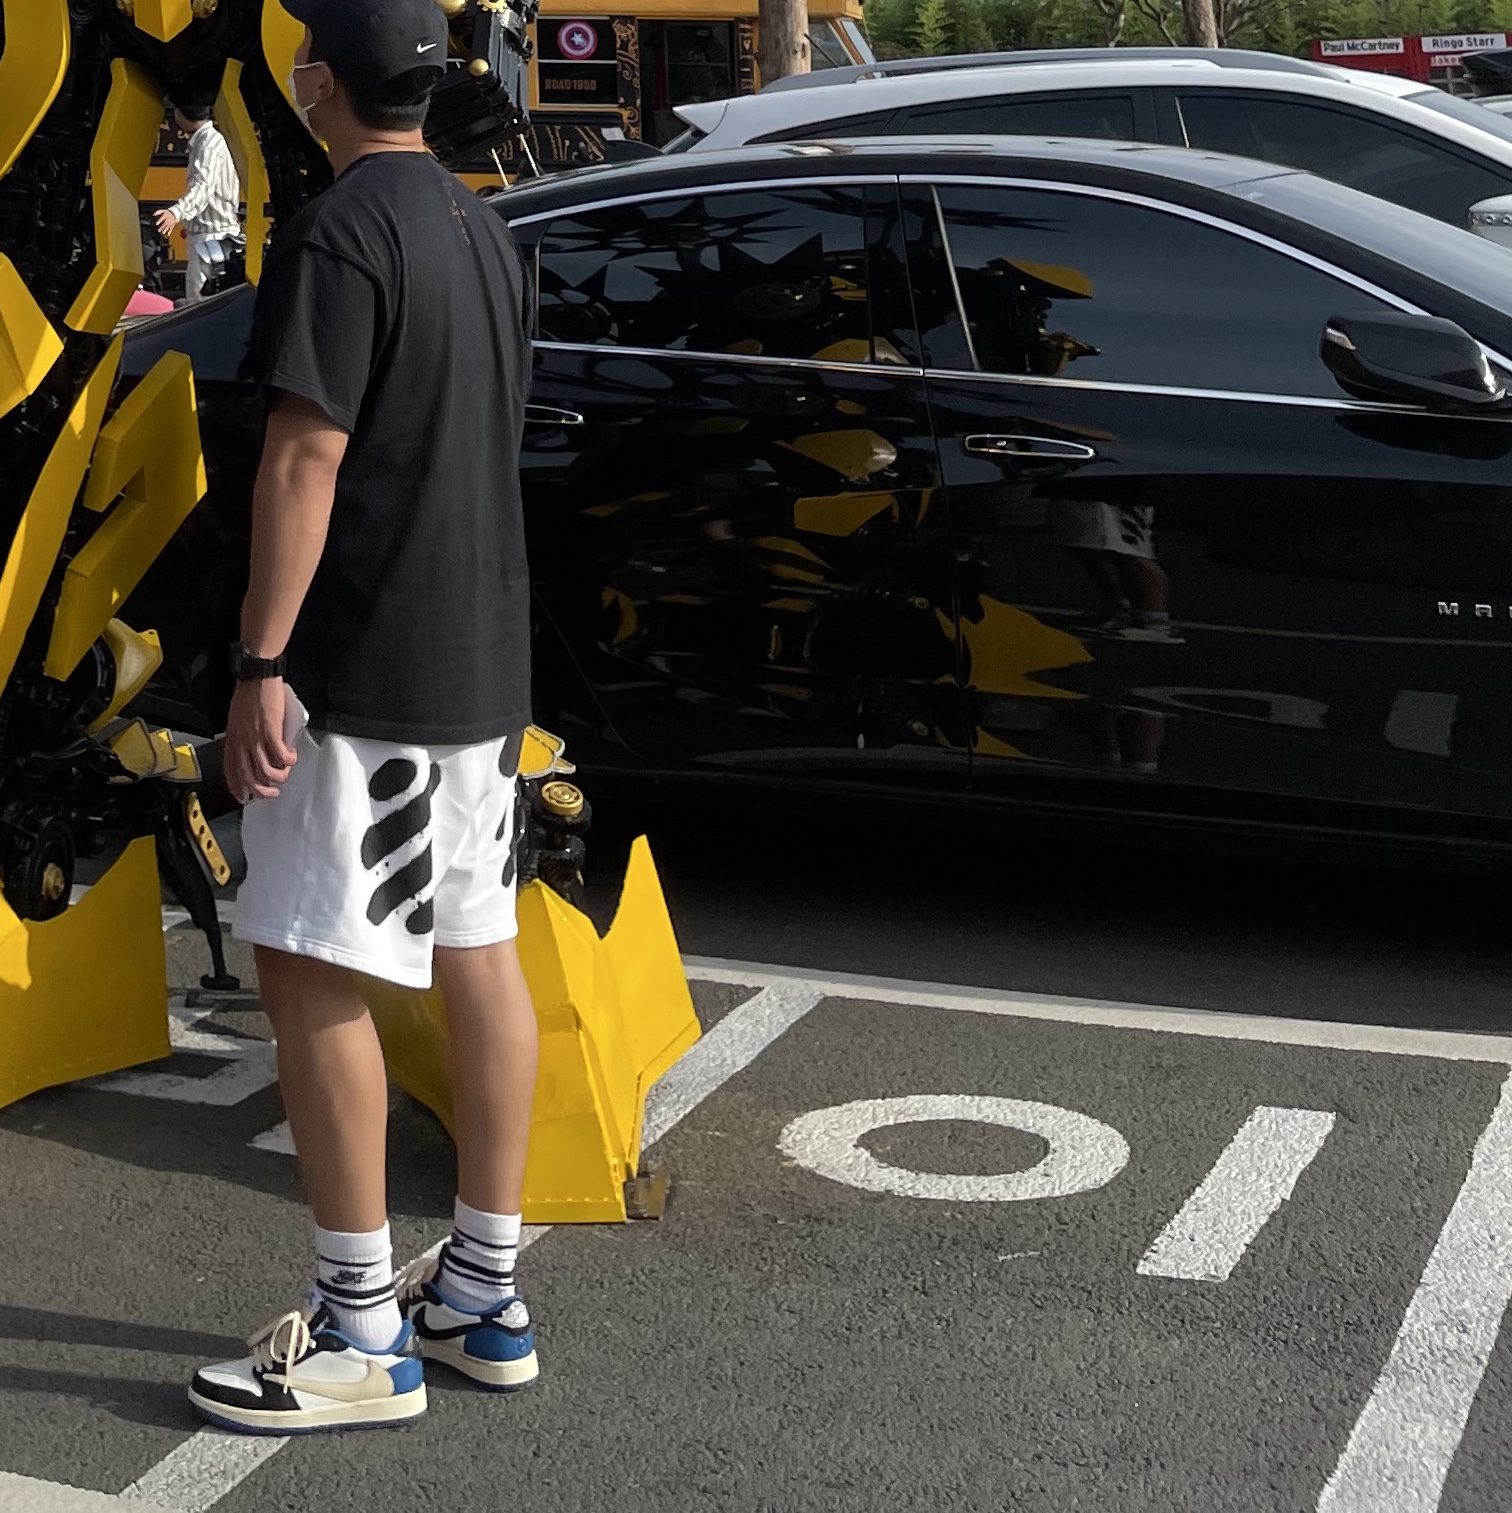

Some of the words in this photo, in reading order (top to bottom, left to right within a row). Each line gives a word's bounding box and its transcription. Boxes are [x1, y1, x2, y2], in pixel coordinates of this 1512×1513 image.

[1323, 43, 1345, 52] Paul
[1347, 40, 1400, 52] McCartney
[1432, 38, 1464, 48] Ringo
[1467, 37, 1495, 47] Starr
[1437, 601, 1512, 619] MA
